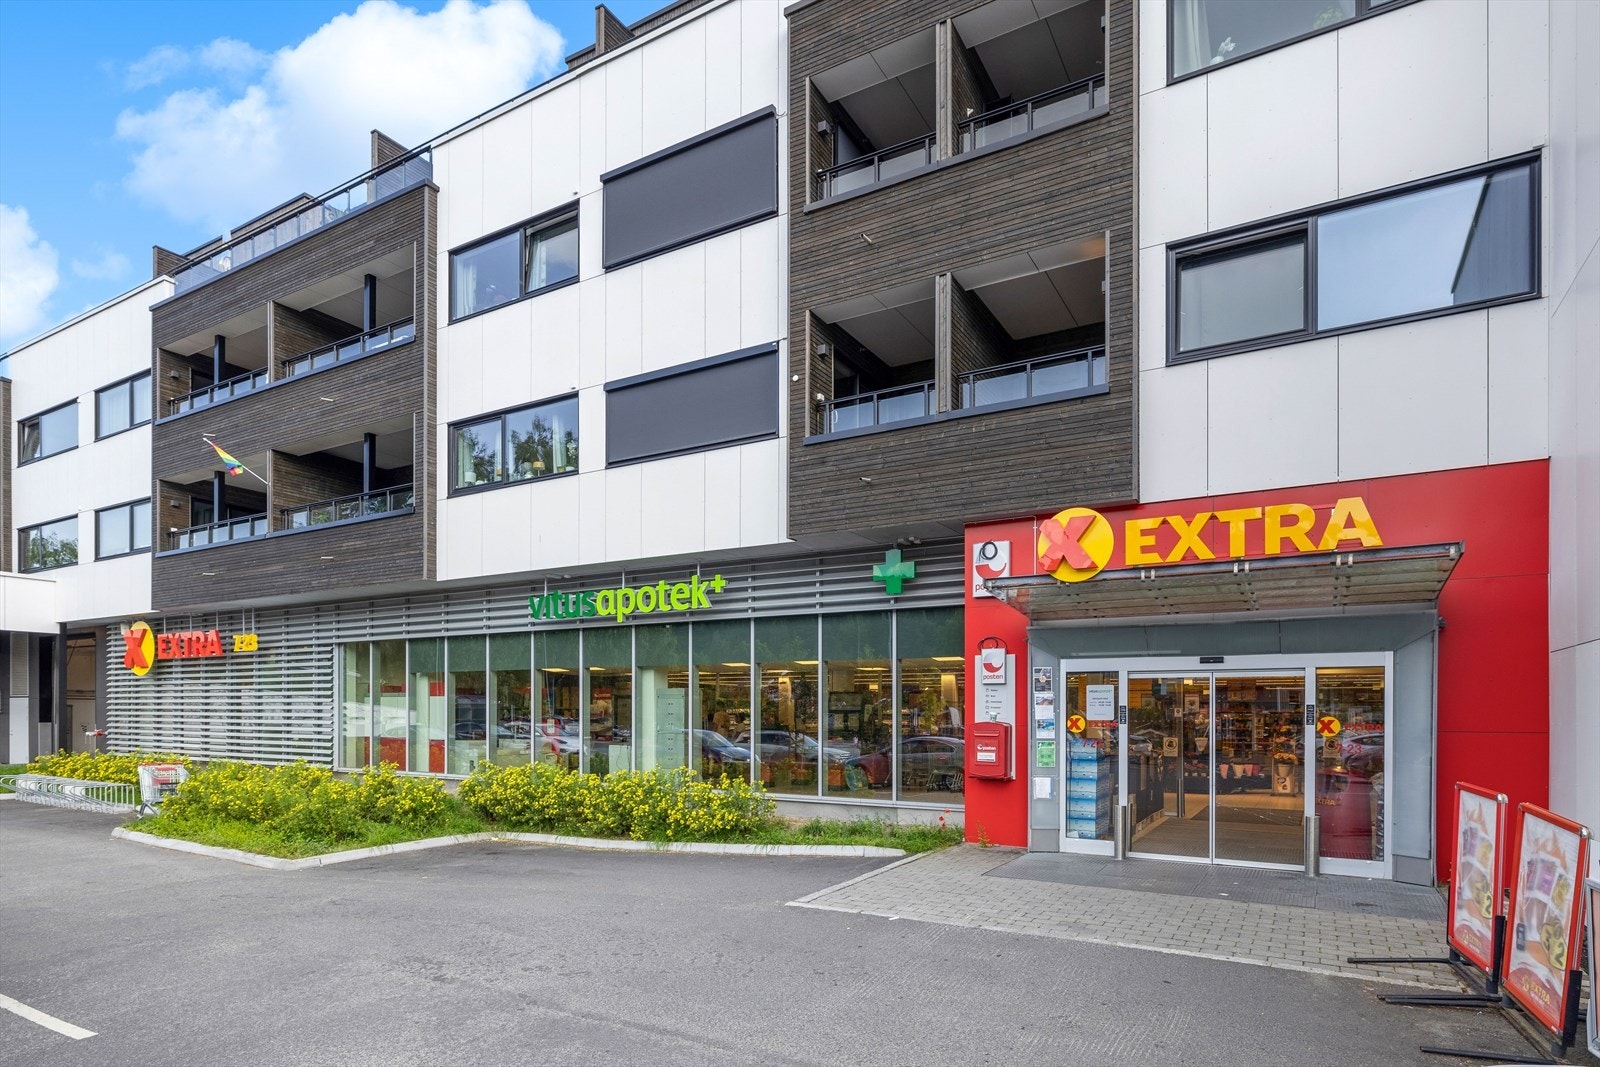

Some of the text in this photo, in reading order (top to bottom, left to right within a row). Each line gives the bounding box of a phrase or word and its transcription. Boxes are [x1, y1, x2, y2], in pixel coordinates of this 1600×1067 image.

[1124, 497, 1384, 567] EXTRA
[157, 629, 223, 660] EXTRA
[982, 673, 1004, 681] posten
[1344, 723, 1383, 731] EXTRA
[1336, 743, 1362, 755] 7-23
